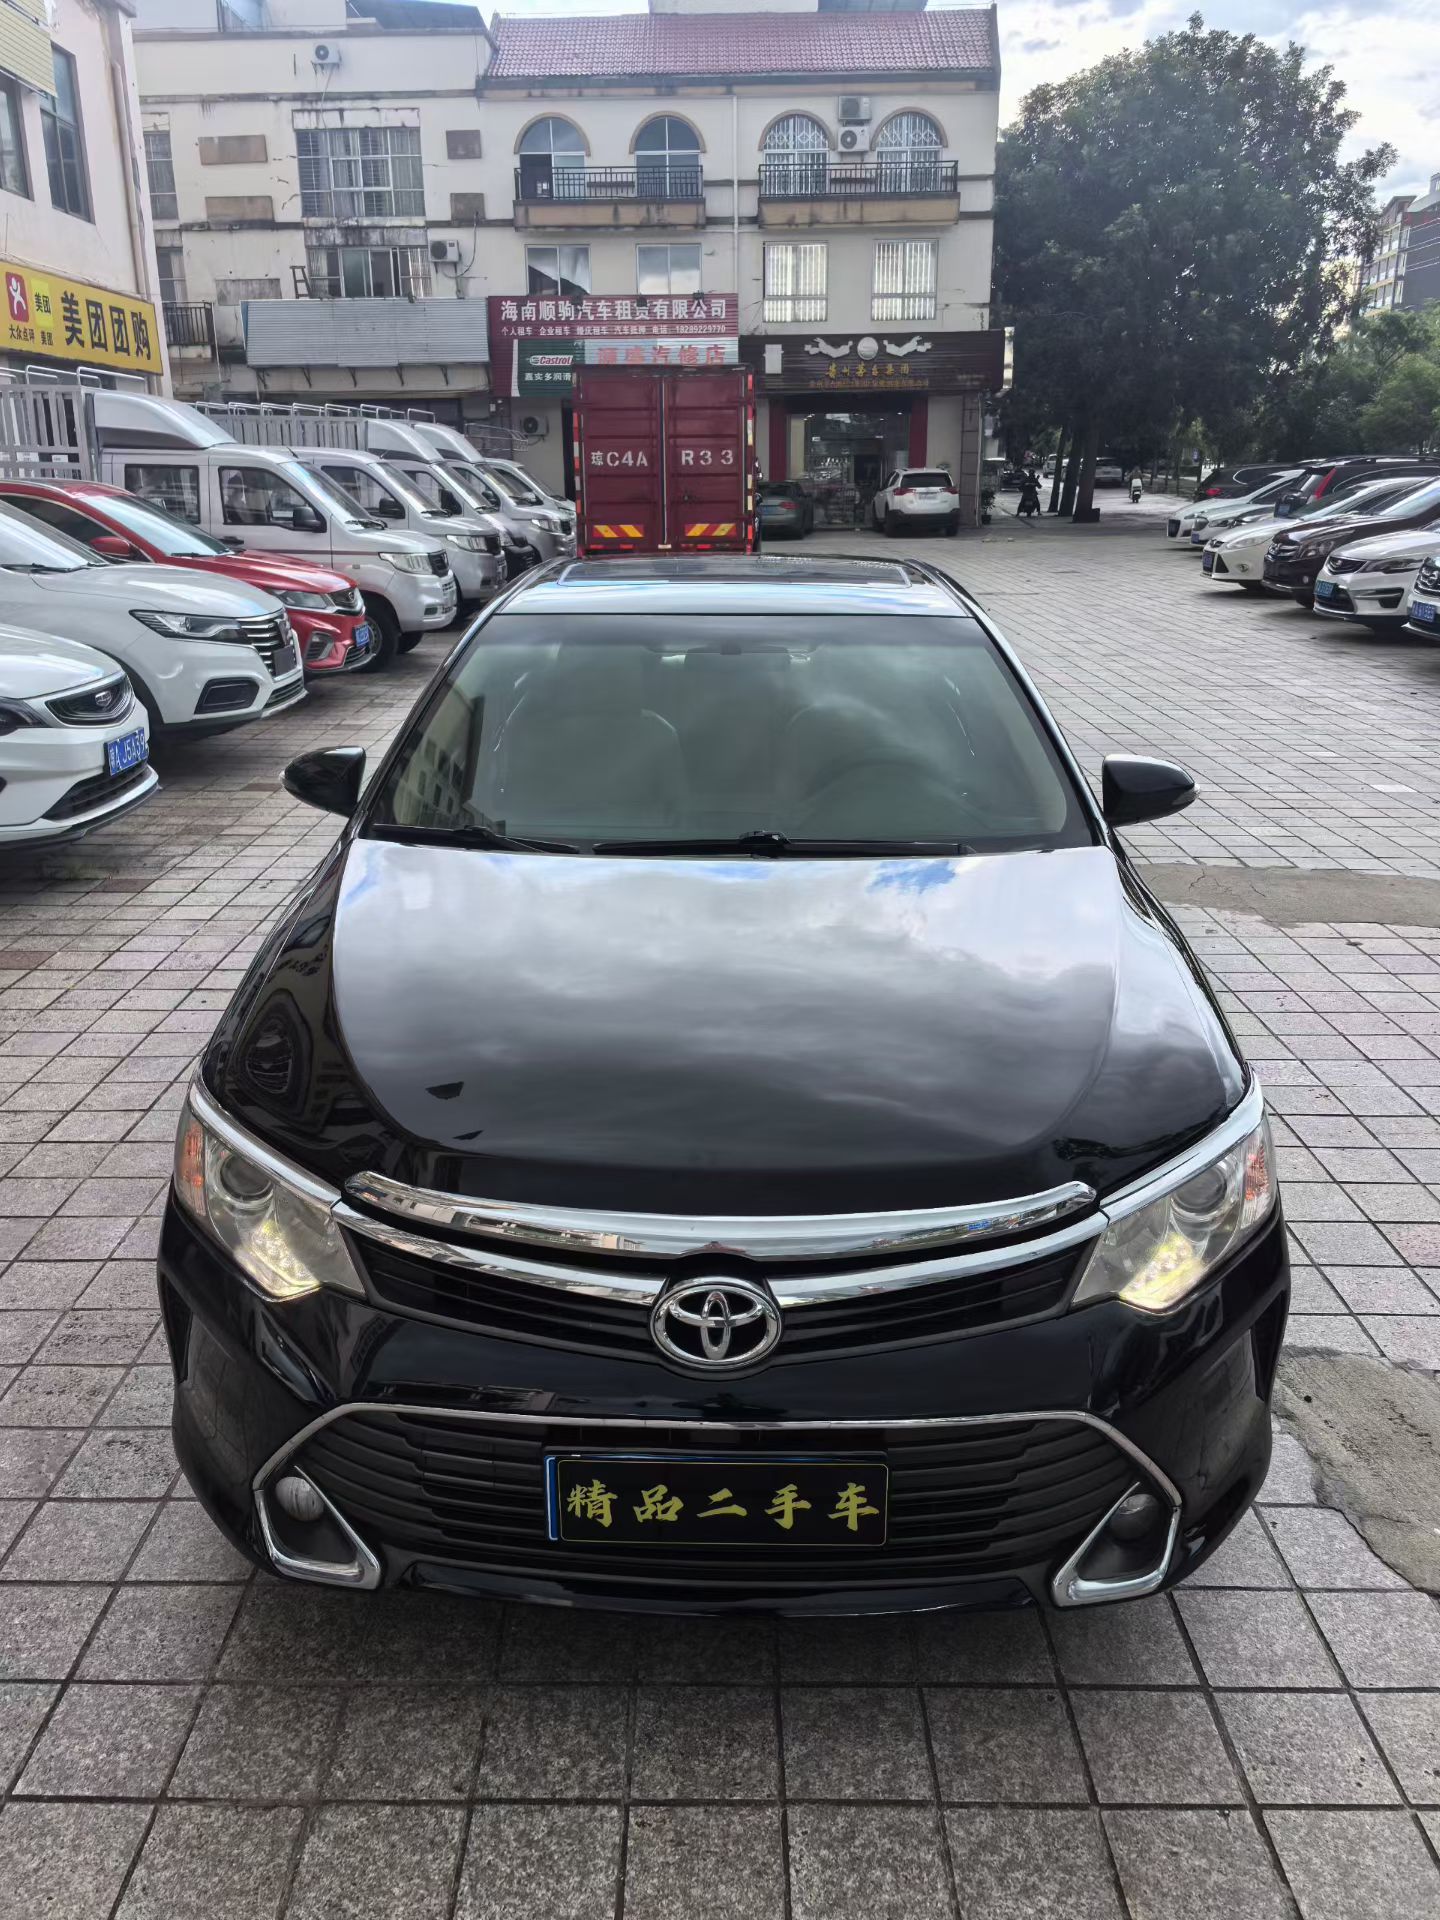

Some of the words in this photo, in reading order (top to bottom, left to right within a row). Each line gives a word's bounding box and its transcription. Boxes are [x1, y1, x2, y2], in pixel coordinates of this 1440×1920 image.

[34, 292, 51, 314] 美团
[61, 290, 151, 361] 美团团购
[501, 327, 532, 336] 个人租车
[540, 326, 571, 336] 企业租车
[540, 356, 571, 365] Castrol
[591, 450, 648, 467] 琼C4A
[566, 1478, 880, 1532] 精品二手车
